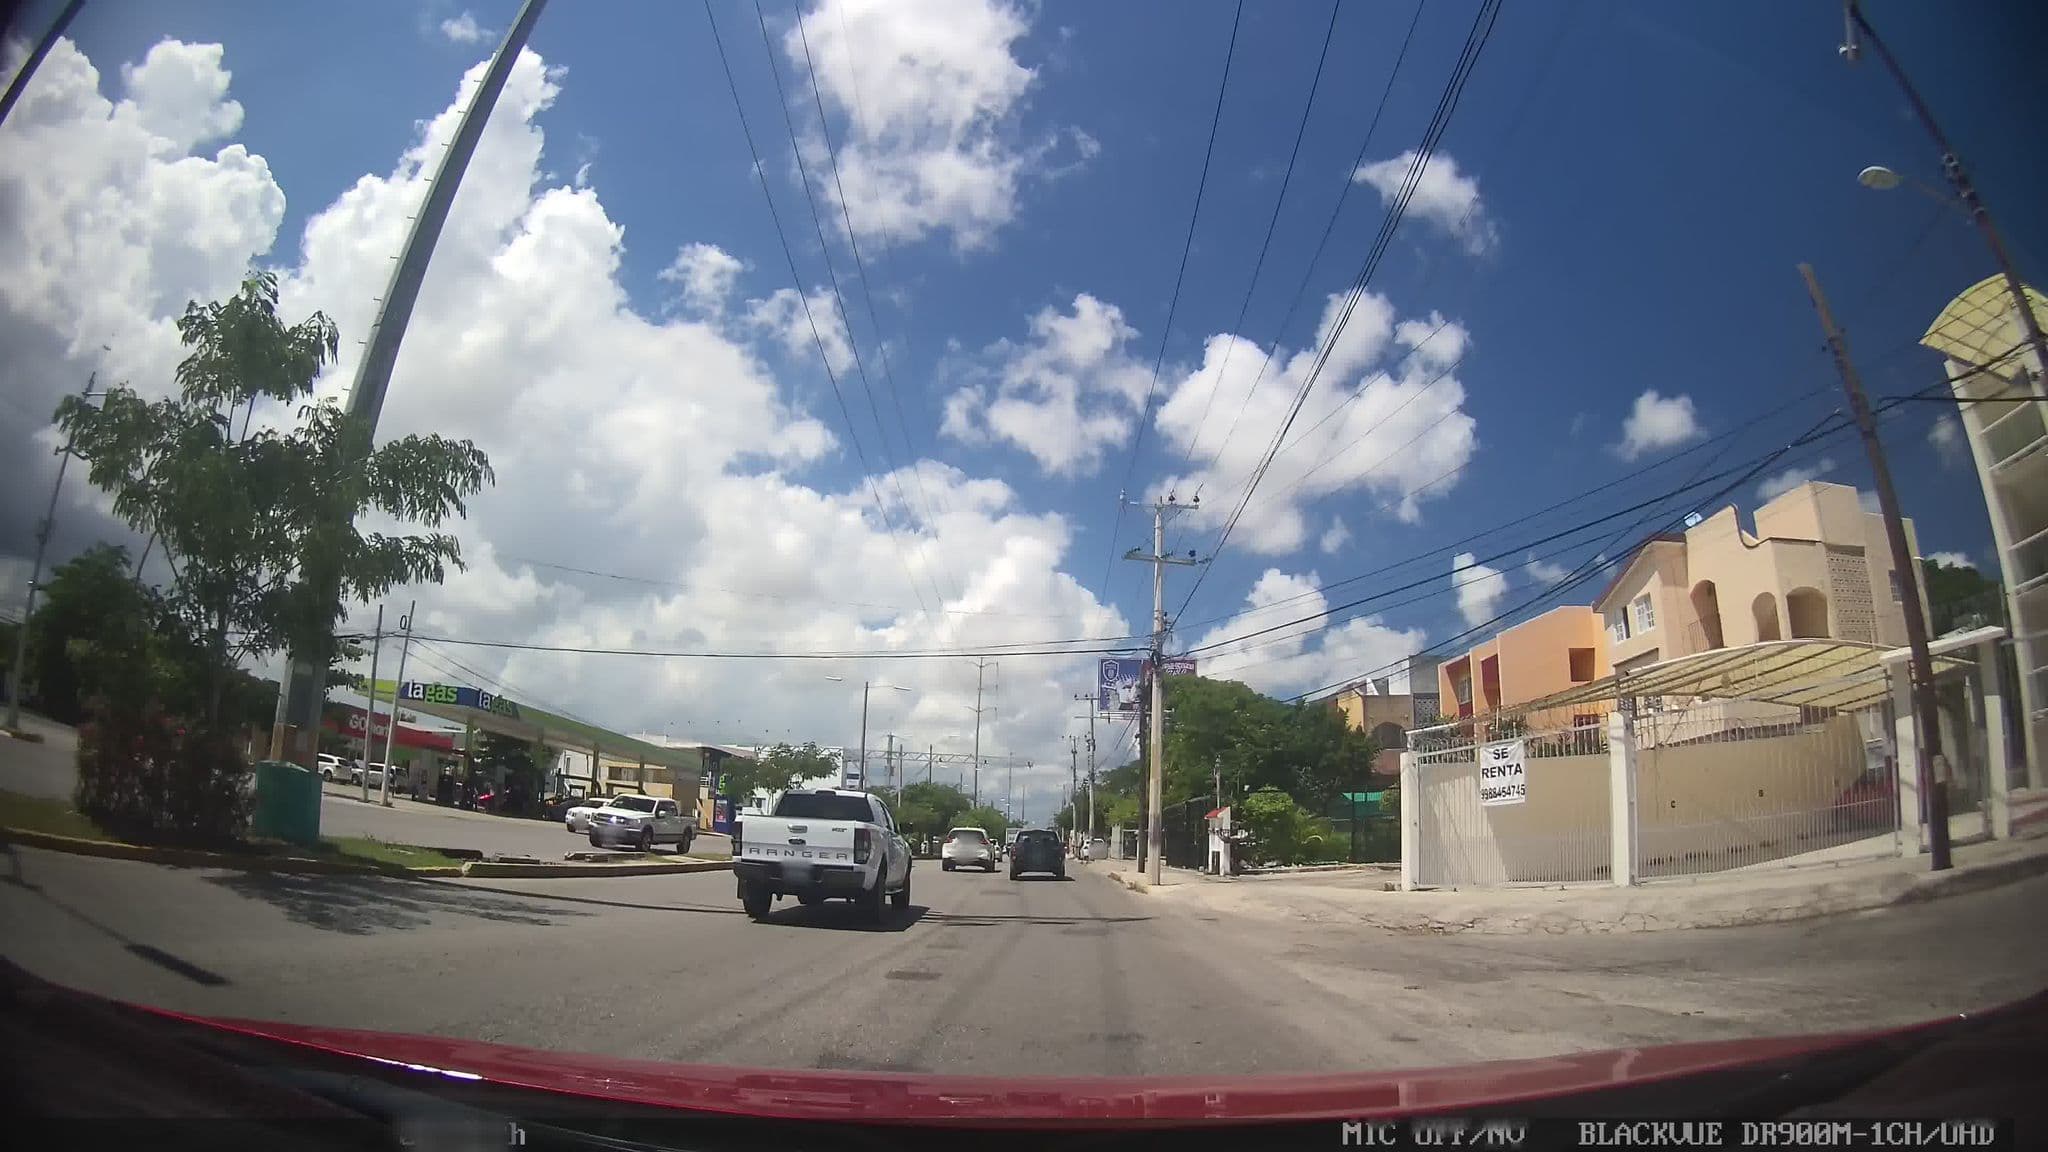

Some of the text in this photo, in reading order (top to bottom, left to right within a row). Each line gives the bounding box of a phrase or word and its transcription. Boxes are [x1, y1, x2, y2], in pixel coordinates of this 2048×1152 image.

[1493, 748, 1508, 760] SE
[1482, 763, 1522, 778] RENTA
[749, 847, 848, 860] RANGER
